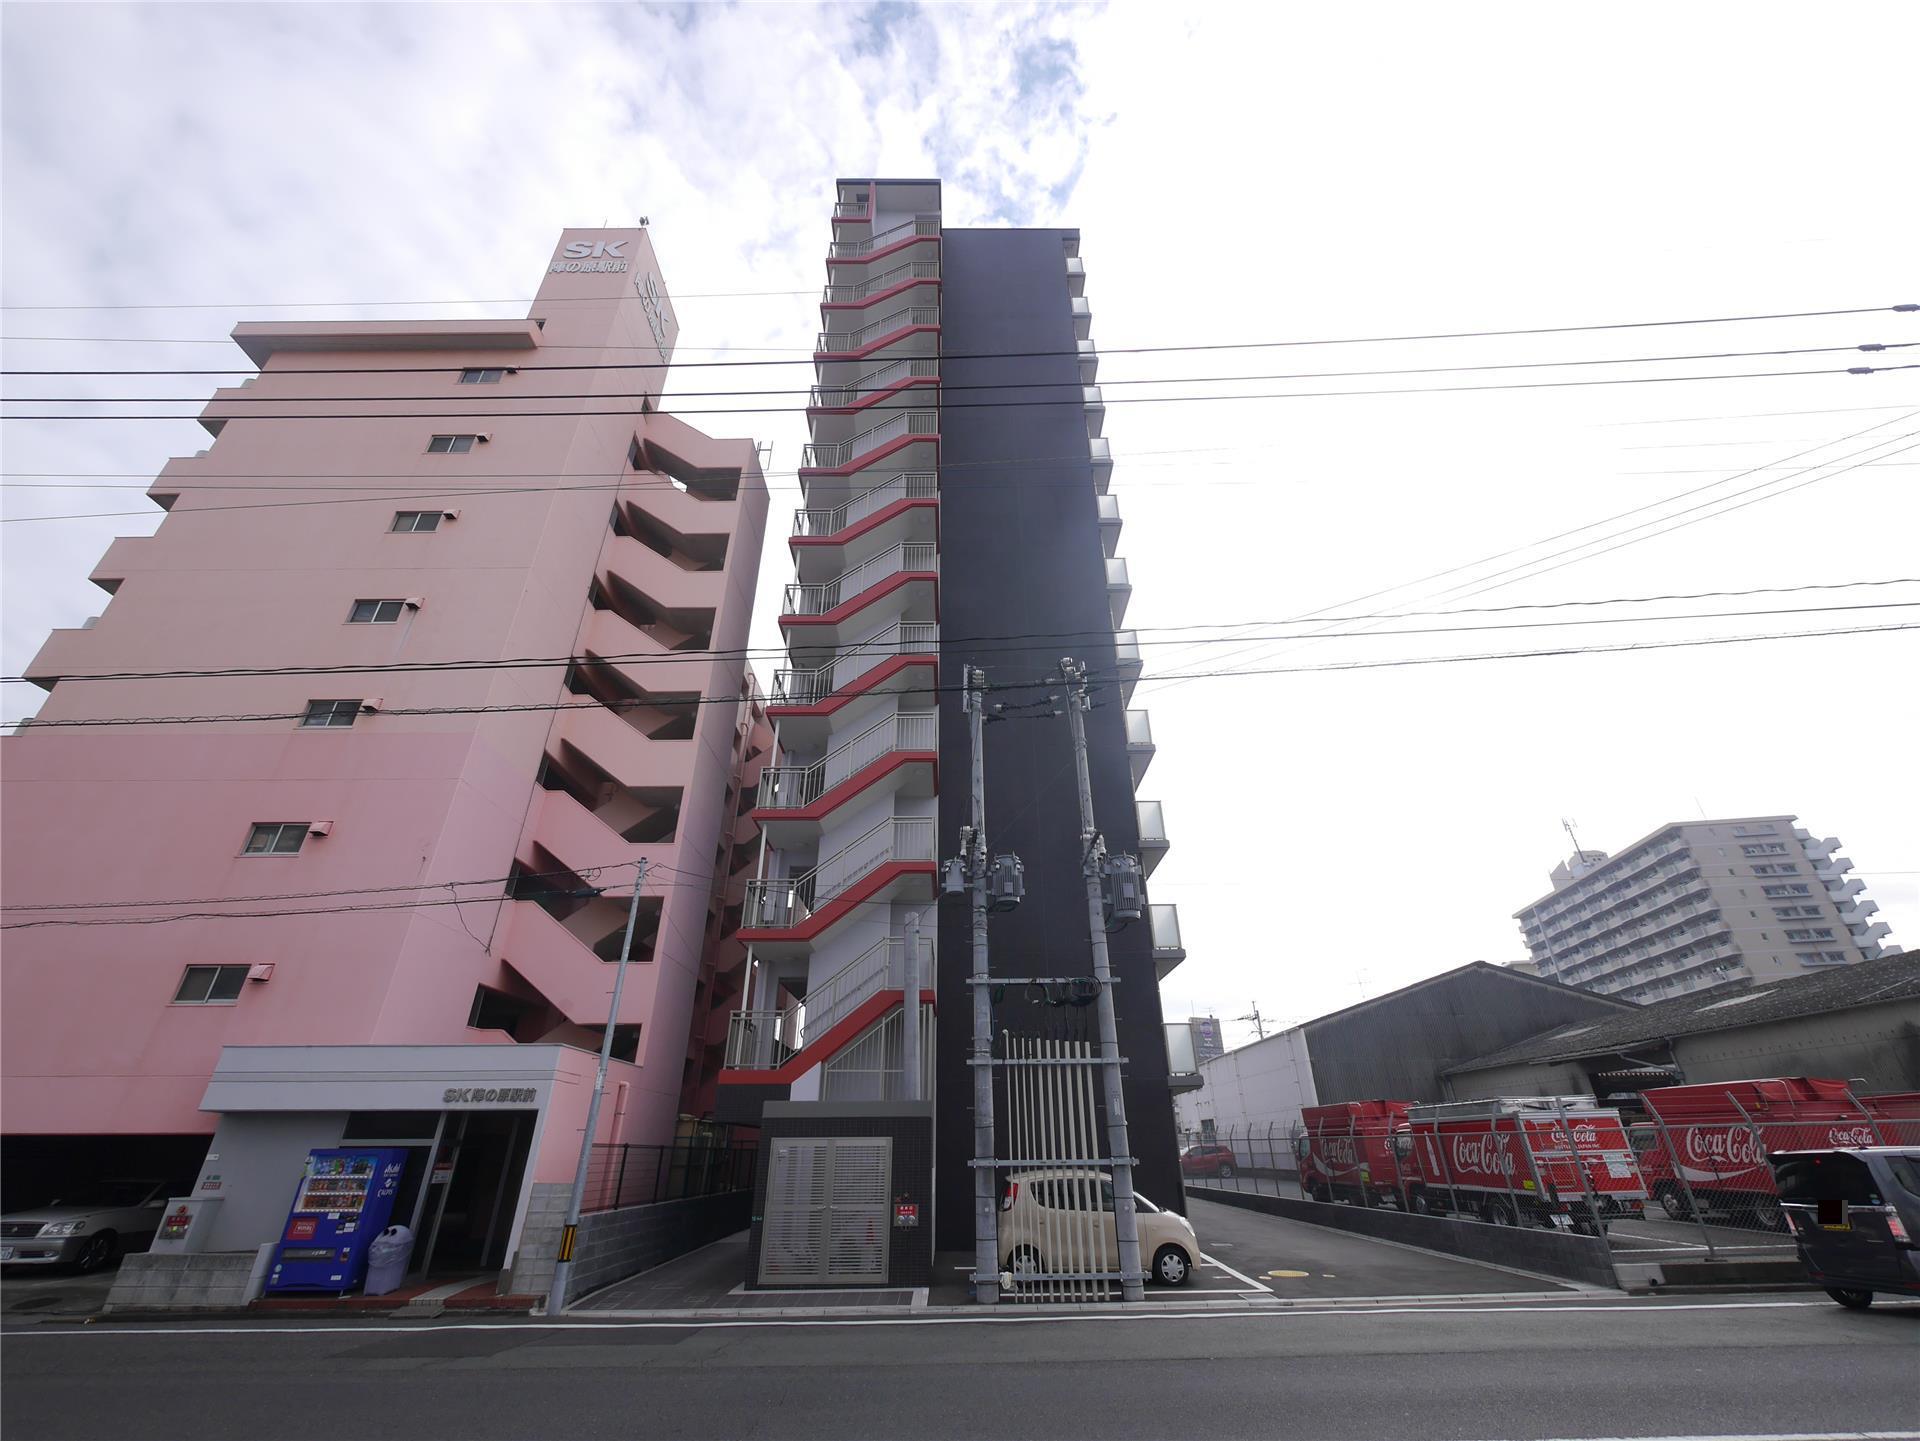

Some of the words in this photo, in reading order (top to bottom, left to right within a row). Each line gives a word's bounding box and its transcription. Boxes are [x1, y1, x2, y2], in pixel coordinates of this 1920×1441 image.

[562, 240, 629, 259] SK
[1829, 1127, 1873, 1145] Coca-Cola
[1453, 1133, 1516, 1175] Coca-Cola
